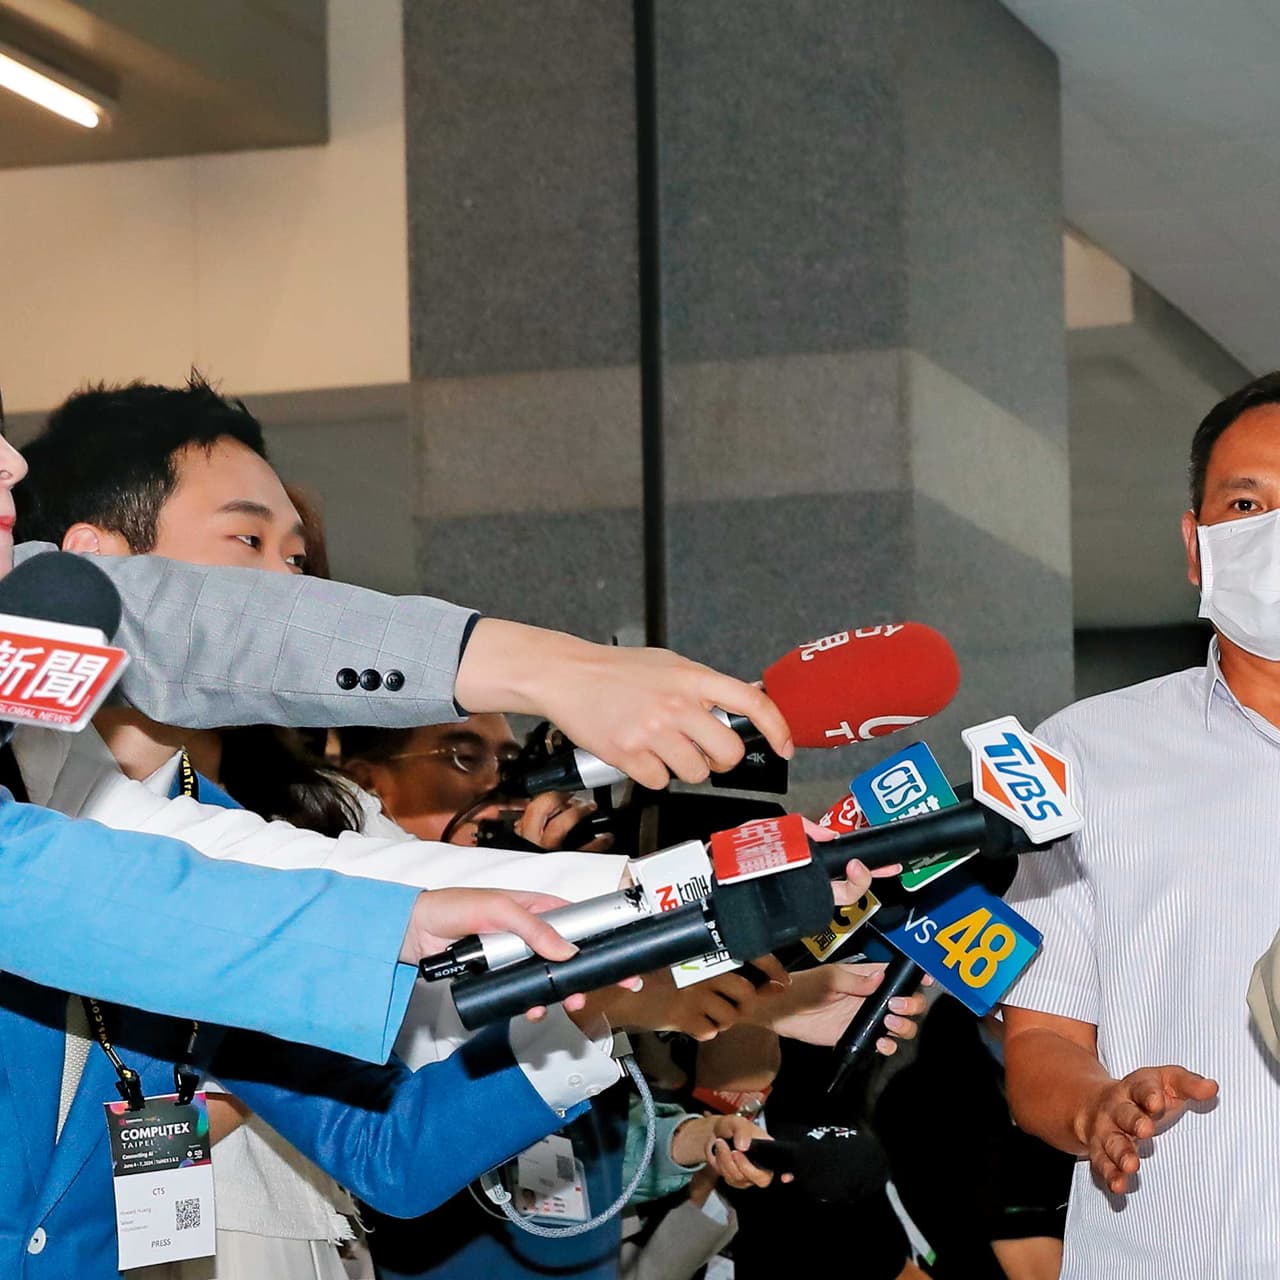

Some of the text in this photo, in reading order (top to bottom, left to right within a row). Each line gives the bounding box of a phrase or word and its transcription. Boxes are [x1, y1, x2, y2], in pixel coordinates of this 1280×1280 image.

[0, 640, 110, 708] 新聞
[38, 711, 73, 724] NEWS
[983, 731, 1062, 822] TVBS
[877, 766, 922, 809] CTS
[934, 907, 1017, 989] 48
[434, 963, 466, 978] SONY
[120, 1122, 190, 1141] COMPUTEX
[122, 1139, 154, 1149] TAIPEI
[151, 1238, 172, 1248] PRESS
